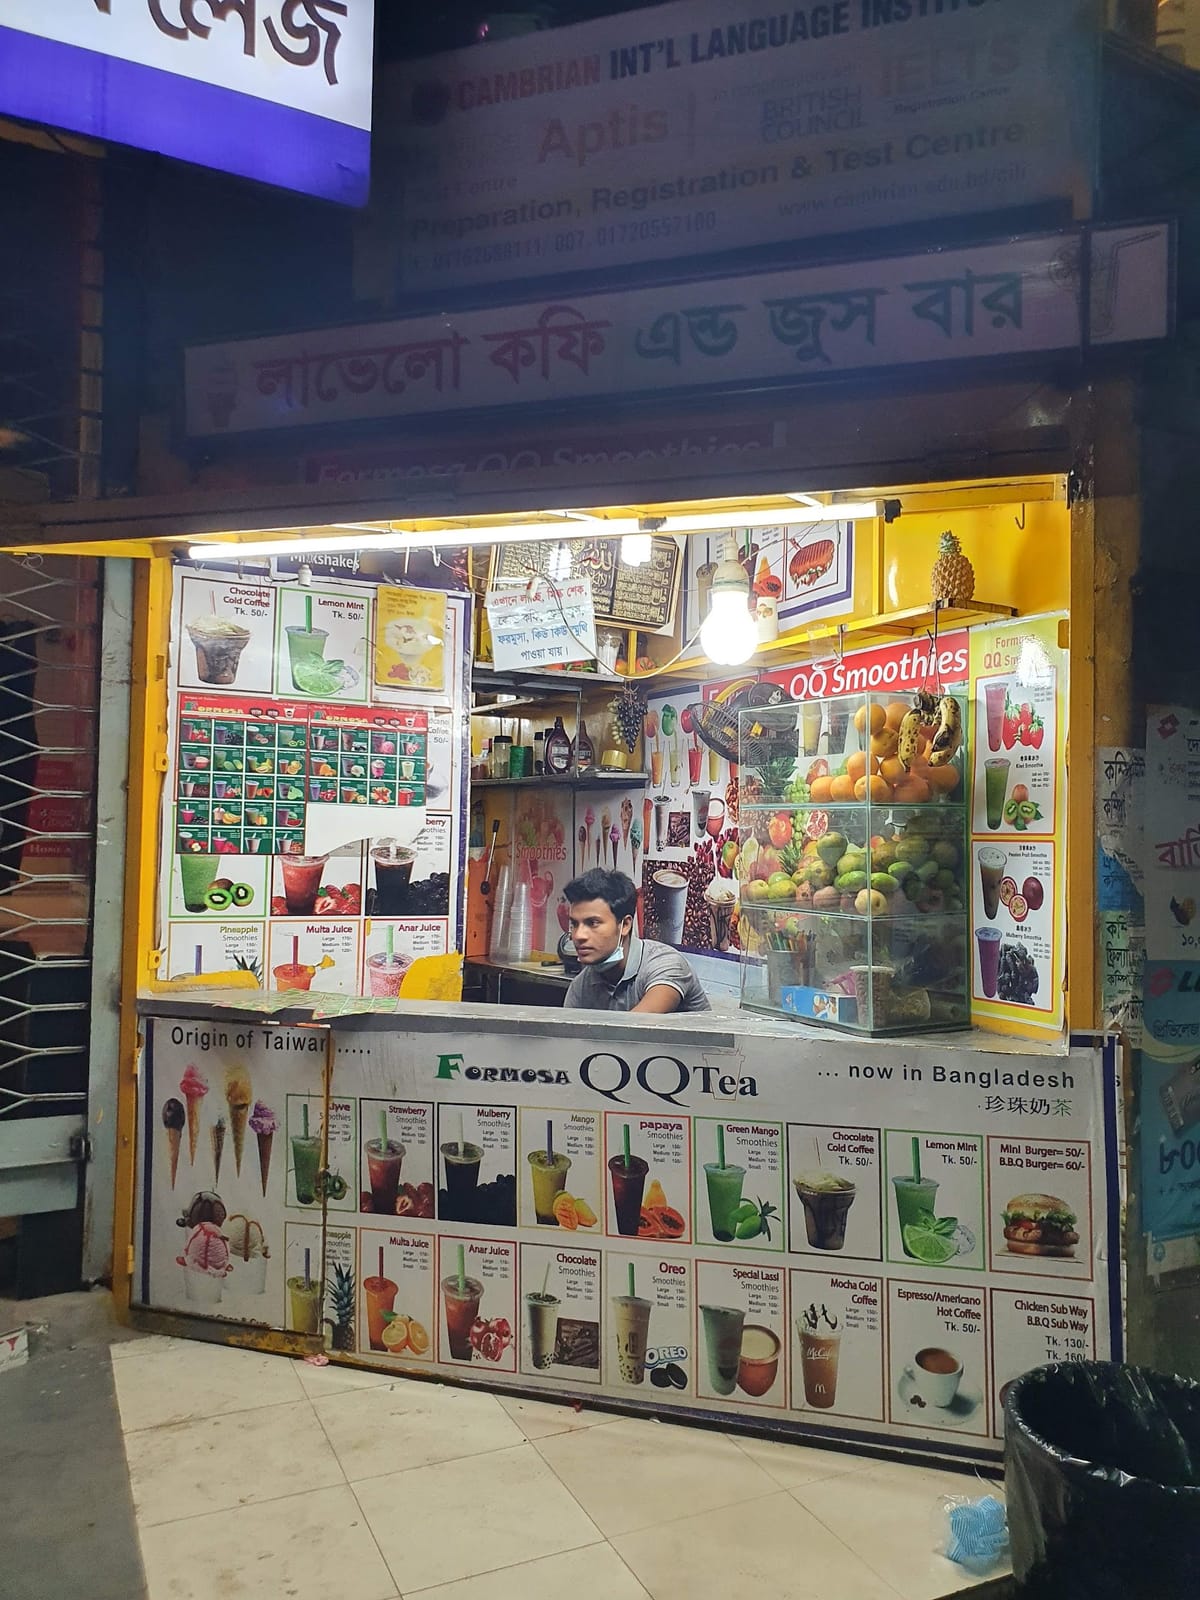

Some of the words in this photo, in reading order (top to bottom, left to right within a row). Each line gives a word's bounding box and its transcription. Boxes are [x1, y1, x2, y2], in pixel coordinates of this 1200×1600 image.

[456, 55, 601, 111] CAMBRIAN
[690, 2, 850, 66] LANGUAGE
[538, 101, 668, 168] Aptis
[590, 159, 779, 212] Registration
[790, 156, 813, 181] &
[827, 140, 894, 174] Test
[905, 121, 1028, 162] Centre
[251, 331, 470, 408] লাভেলো
[480, 304, 613, 385] কফি
[763, 286, 890, 367] জুস
[903, 267, 1025, 339] বার
[229, 587, 270, 599] Chocolate
[223, 596, 245, 607] Cold
[247, 597, 270, 608] Coffee
[318, 598, 344, 609] Lemon
[346, 600, 364, 611] Mint
[234, 607, 248, 616] Tk.
[251, 607, 268, 618] 50/-
[332, 611, 346, 621] Tk.
[348, 611, 364, 622] 50/-
[791, 672, 828, 701] QQ
[833, 651, 968, 693] Smoothies
[219, 926, 259, 937] Pineapple
[306, 925, 331, 938] Multa
[332, 926, 353, 938] Juice
[398, 923, 419, 935] Anar
[421, 924, 442, 936] Juice
[223, 935, 258, 944] Smoothies
[171, 1026, 228, 1051] Origin
[236, 1031, 254, 1049] of
[579, 1052, 691, 1107] QQ
[693, 1065, 759, 1097] Tea
[849, 1065, 894, 1081] now
[903, 1064, 922, 1081] in
[933, 1066, 1074, 1089] Bangladesh
[388, 1105, 427, 1117] Strawberry
[984, 1095, 1073, 1117] 珍珠奶茶
[477, 1108, 511, 1119] Mulberry
[571, 1114, 595, 1125] Mango
[395, 1116, 427, 1125] Smoothies
[477, 1119, 511, 1129] Smoothies
[639, 1120, 683, 1132] papaya
[563, 1123, 594, 1133] Smoothies
[726, 1123, 749, 1134] Green
[751, 1125, 779, 1138] Mango
[647, 1131, 683, 1141] Smoothies
[736, 1136, 778, 1148] Smoothies
[832, 1131, 874, 1142] Chocolate
[827, 1143, 846, 1153] Cold
[848, 1144, 874, 1154] Coffee
[926, 1139, 956, 1151] Lemon
[957, 1142, 977, 1153] Mint
[1000, 1144, 1021, 1154] Mini
[1065, 1148, 1085, 1157] 50/-
[839, 1155, 853, 1166] Tk.
[855, 1157, 873, 1167] 50/-
[942, 1154, 956, 1165] Tk.
[959, 1156, 977, 1166] 50/-
[999, 1157, 1023, 1168] B.B.Q
[1065, 1161, 1085, 1170] 60/-
[389, 1236, 409, 1247] Multa
[411, 1239, 429, 1249] Juice
[468, 1243, 487, 1255] Anar
[488, 1246, 510, 1257] Juice
[557, 1251, 597, 1266] Chocolate
[558, 1263, 596, 1278] Smoothies
[659, 1262, 686, 1275] Oreo
[733, 1268, 761, 1281] Special
[762, 1271, 780, 1281] Lassi
[652, 1276, 686, 1286] Smoothies
[741, 1281, 779, 1293] Smoothies
[830, 1278, 857, 1290] Mocha
[858, 1282, 878, 1293] Cold
[851, 1294, 878, 1306] Coffee
[897, 1289, 981, 1306] Espresso/Americano
[936, 1307, 952, 1318] Hot
[954, 1308, 982, 1320] Coffee
[1014, 1300, 1049, 1313] Chicken
[1051, 1303, 1068, 1315] Sub
[1069, 1305, 1088, 1319] Way
[944, 1322, 959, 1332] Tk.
[962, 1323, 981, 1334] 50/-
[1051, 1318, 1068, 1330] Sub
[1069, 1319, 1089, 1334] Way
[1045, 1336, 1061, 1346] Tk.
[1064, 1338, 1089, 1349] 130/-
[645, 1346, 688, 1365] OREO
[1046, 1350, 1062, 1360] Tk.
